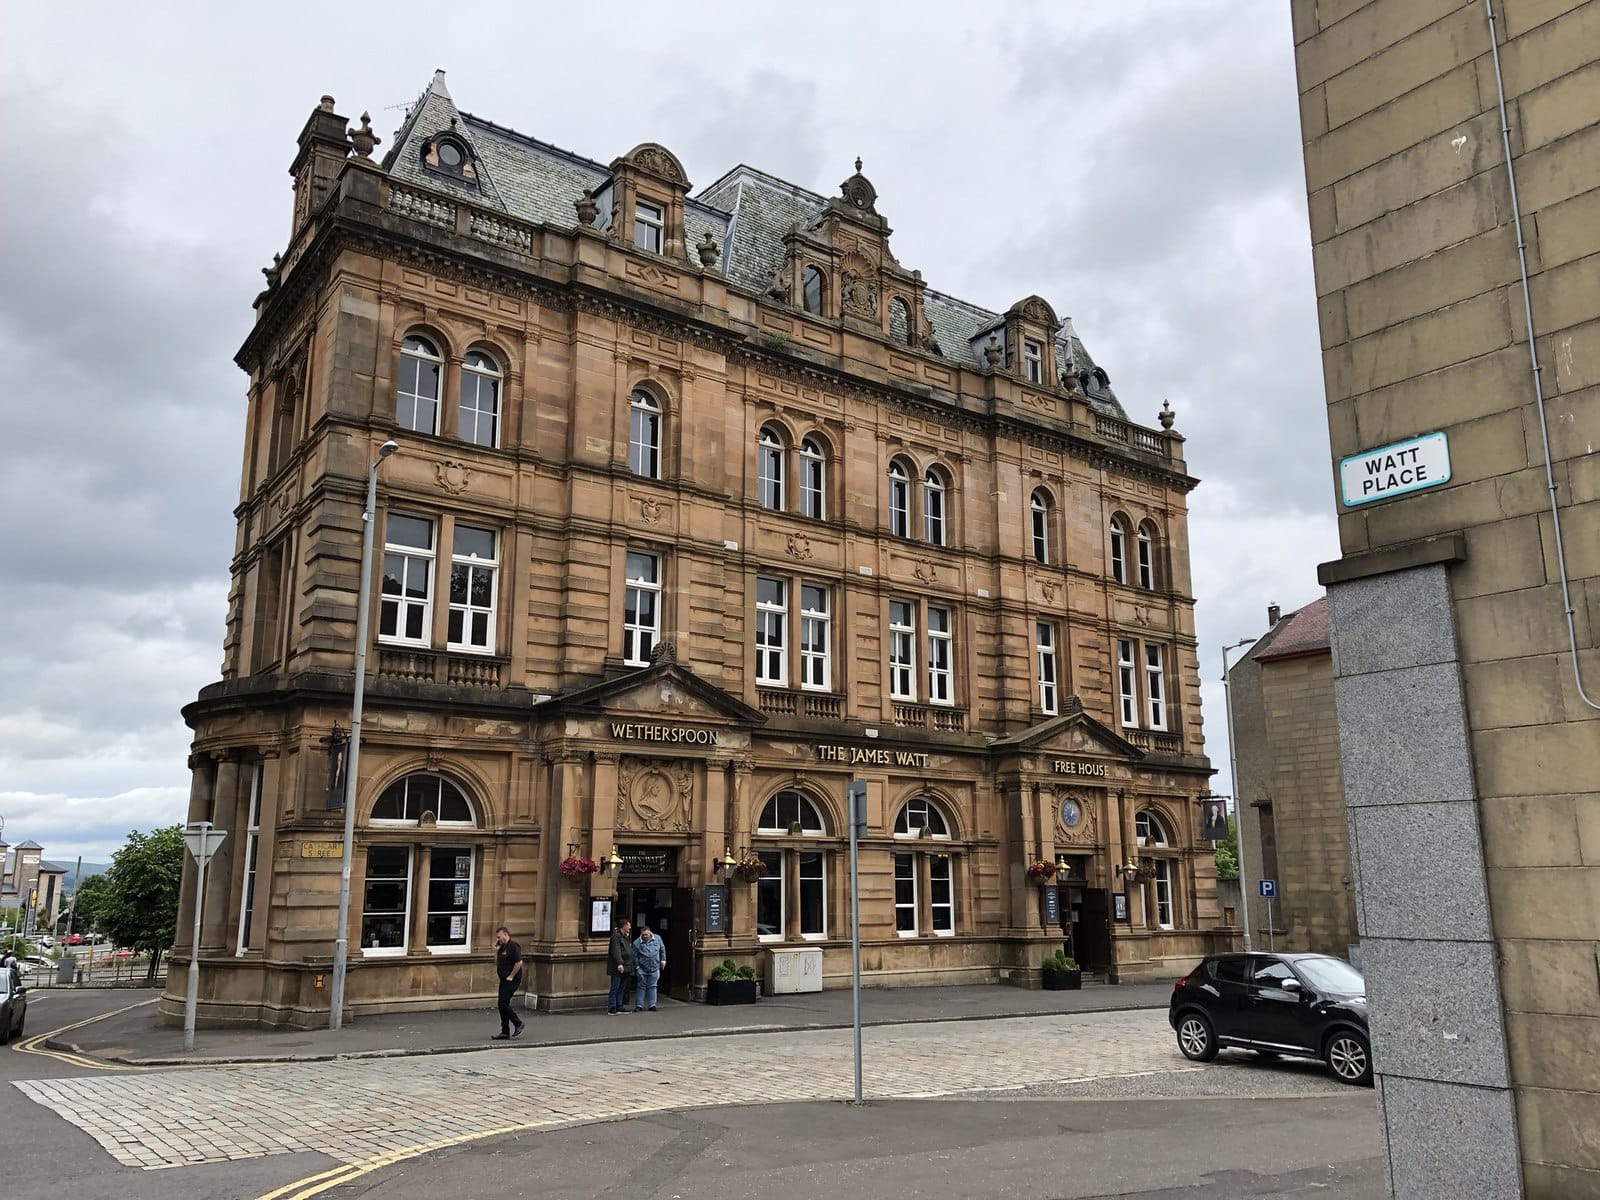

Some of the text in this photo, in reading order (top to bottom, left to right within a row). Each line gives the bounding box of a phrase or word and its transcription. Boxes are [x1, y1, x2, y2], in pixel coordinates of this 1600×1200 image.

[1365, 447, 1420, 475] WATT
[1362, 465, 1427, 495] PLACE
[611, 722, 719, 744] WETHERSPOON
[818, 745, 929, 767] THE JAMES WATT
[1055, 760, 1110, 776] FREE HOUSE
